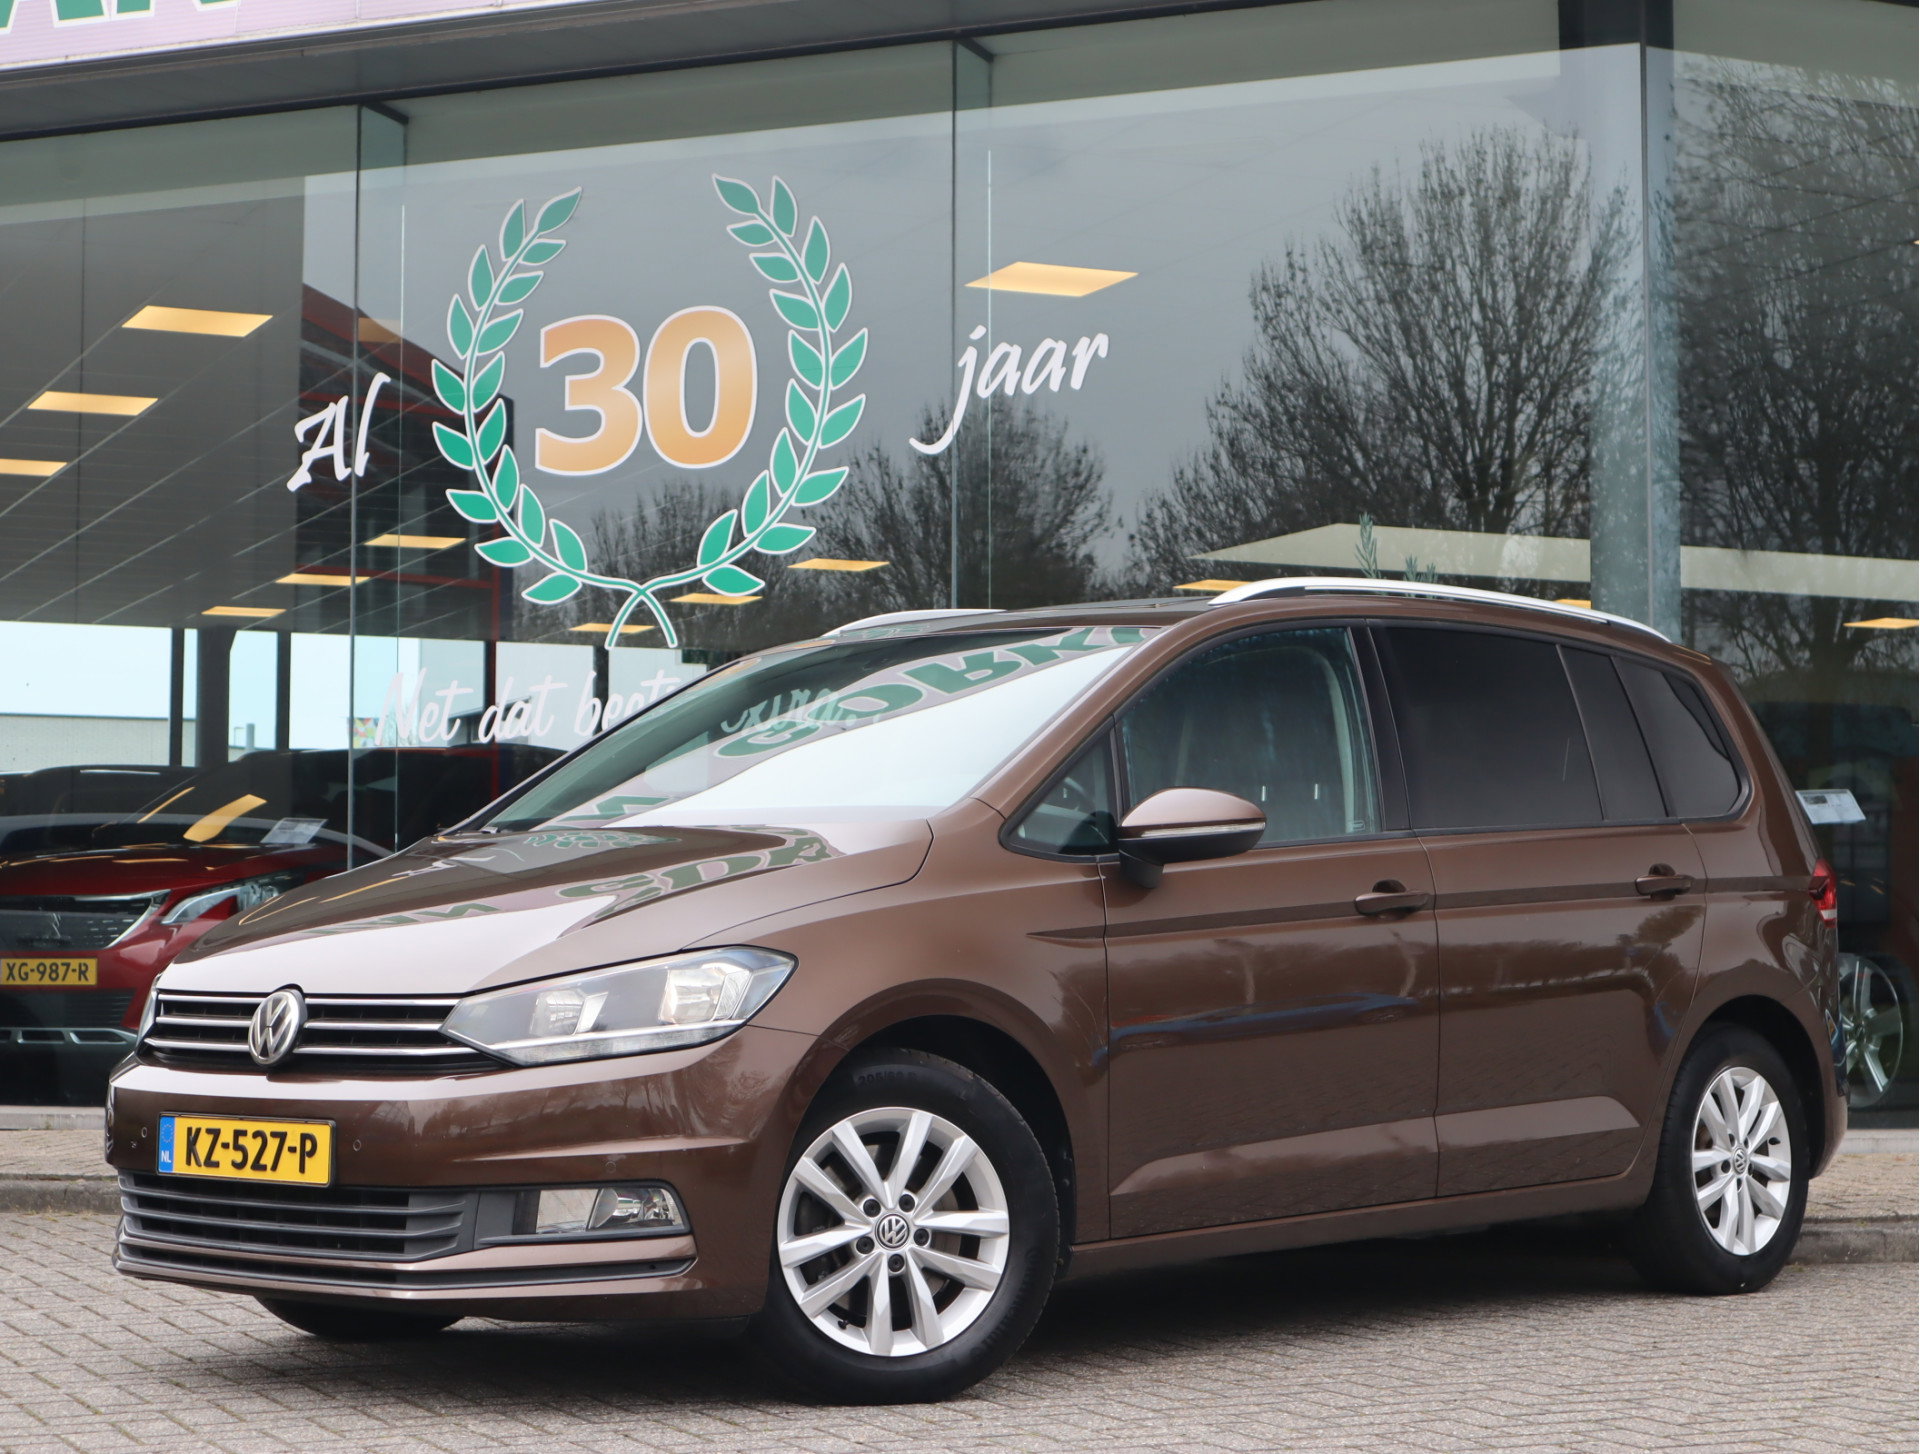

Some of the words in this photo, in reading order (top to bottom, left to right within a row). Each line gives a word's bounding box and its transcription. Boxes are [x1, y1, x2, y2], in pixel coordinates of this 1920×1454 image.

[286, 372, 391, 492] Al
[535, 305, 757, 476] 30
[909, 324, 1109, 455] jaar
[374, 667, 474, 746] Net
[477, 674, 569, 744] dat
[6, 961, 90, 982] XG-987-R
[161, 1150, 172, 1163] NL
[185, 1126, 318, 1174] KZ-527-P
